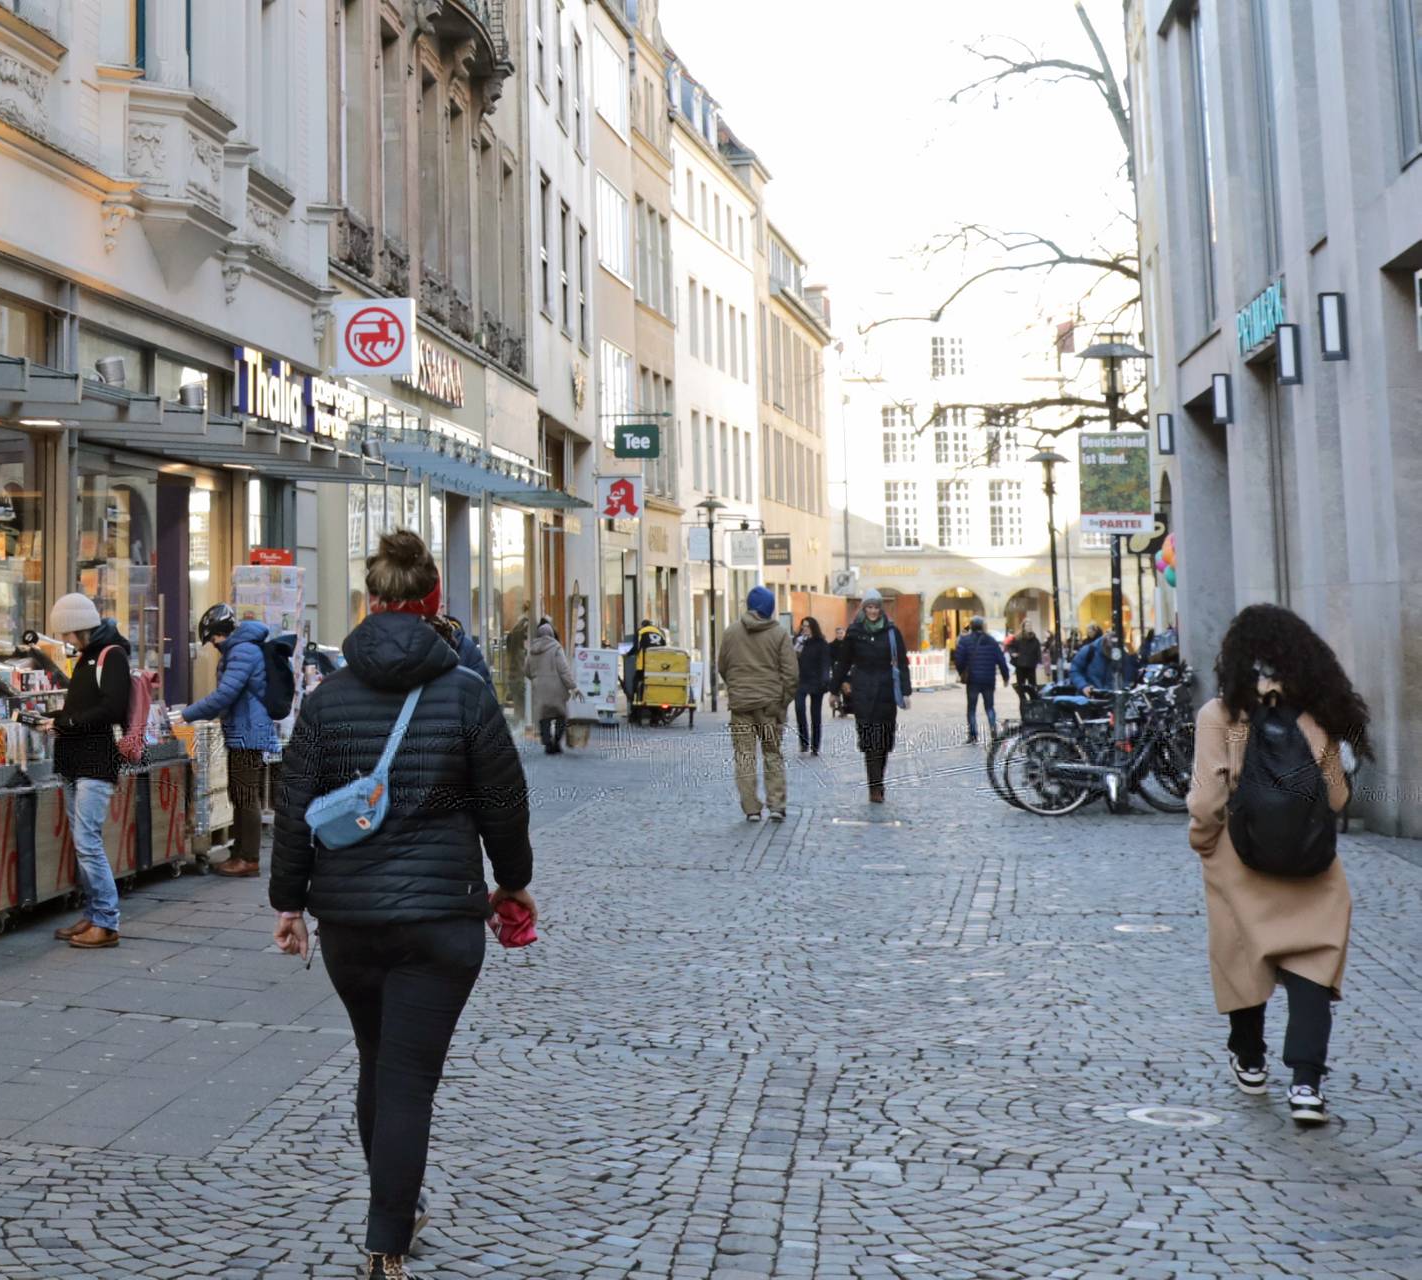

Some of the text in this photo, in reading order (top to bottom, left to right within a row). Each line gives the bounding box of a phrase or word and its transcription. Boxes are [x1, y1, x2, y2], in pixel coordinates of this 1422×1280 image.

[401, 336, 465, 408] OSSMANN
[243, 347, 303, 429] Thalia
[622, 433, 651, 450] Tee
[1081, 436, 1146, 448] Deutschland
[1082, 453, 1097, 464] ist
[1099, 519, 1141, 528] PARTEI
